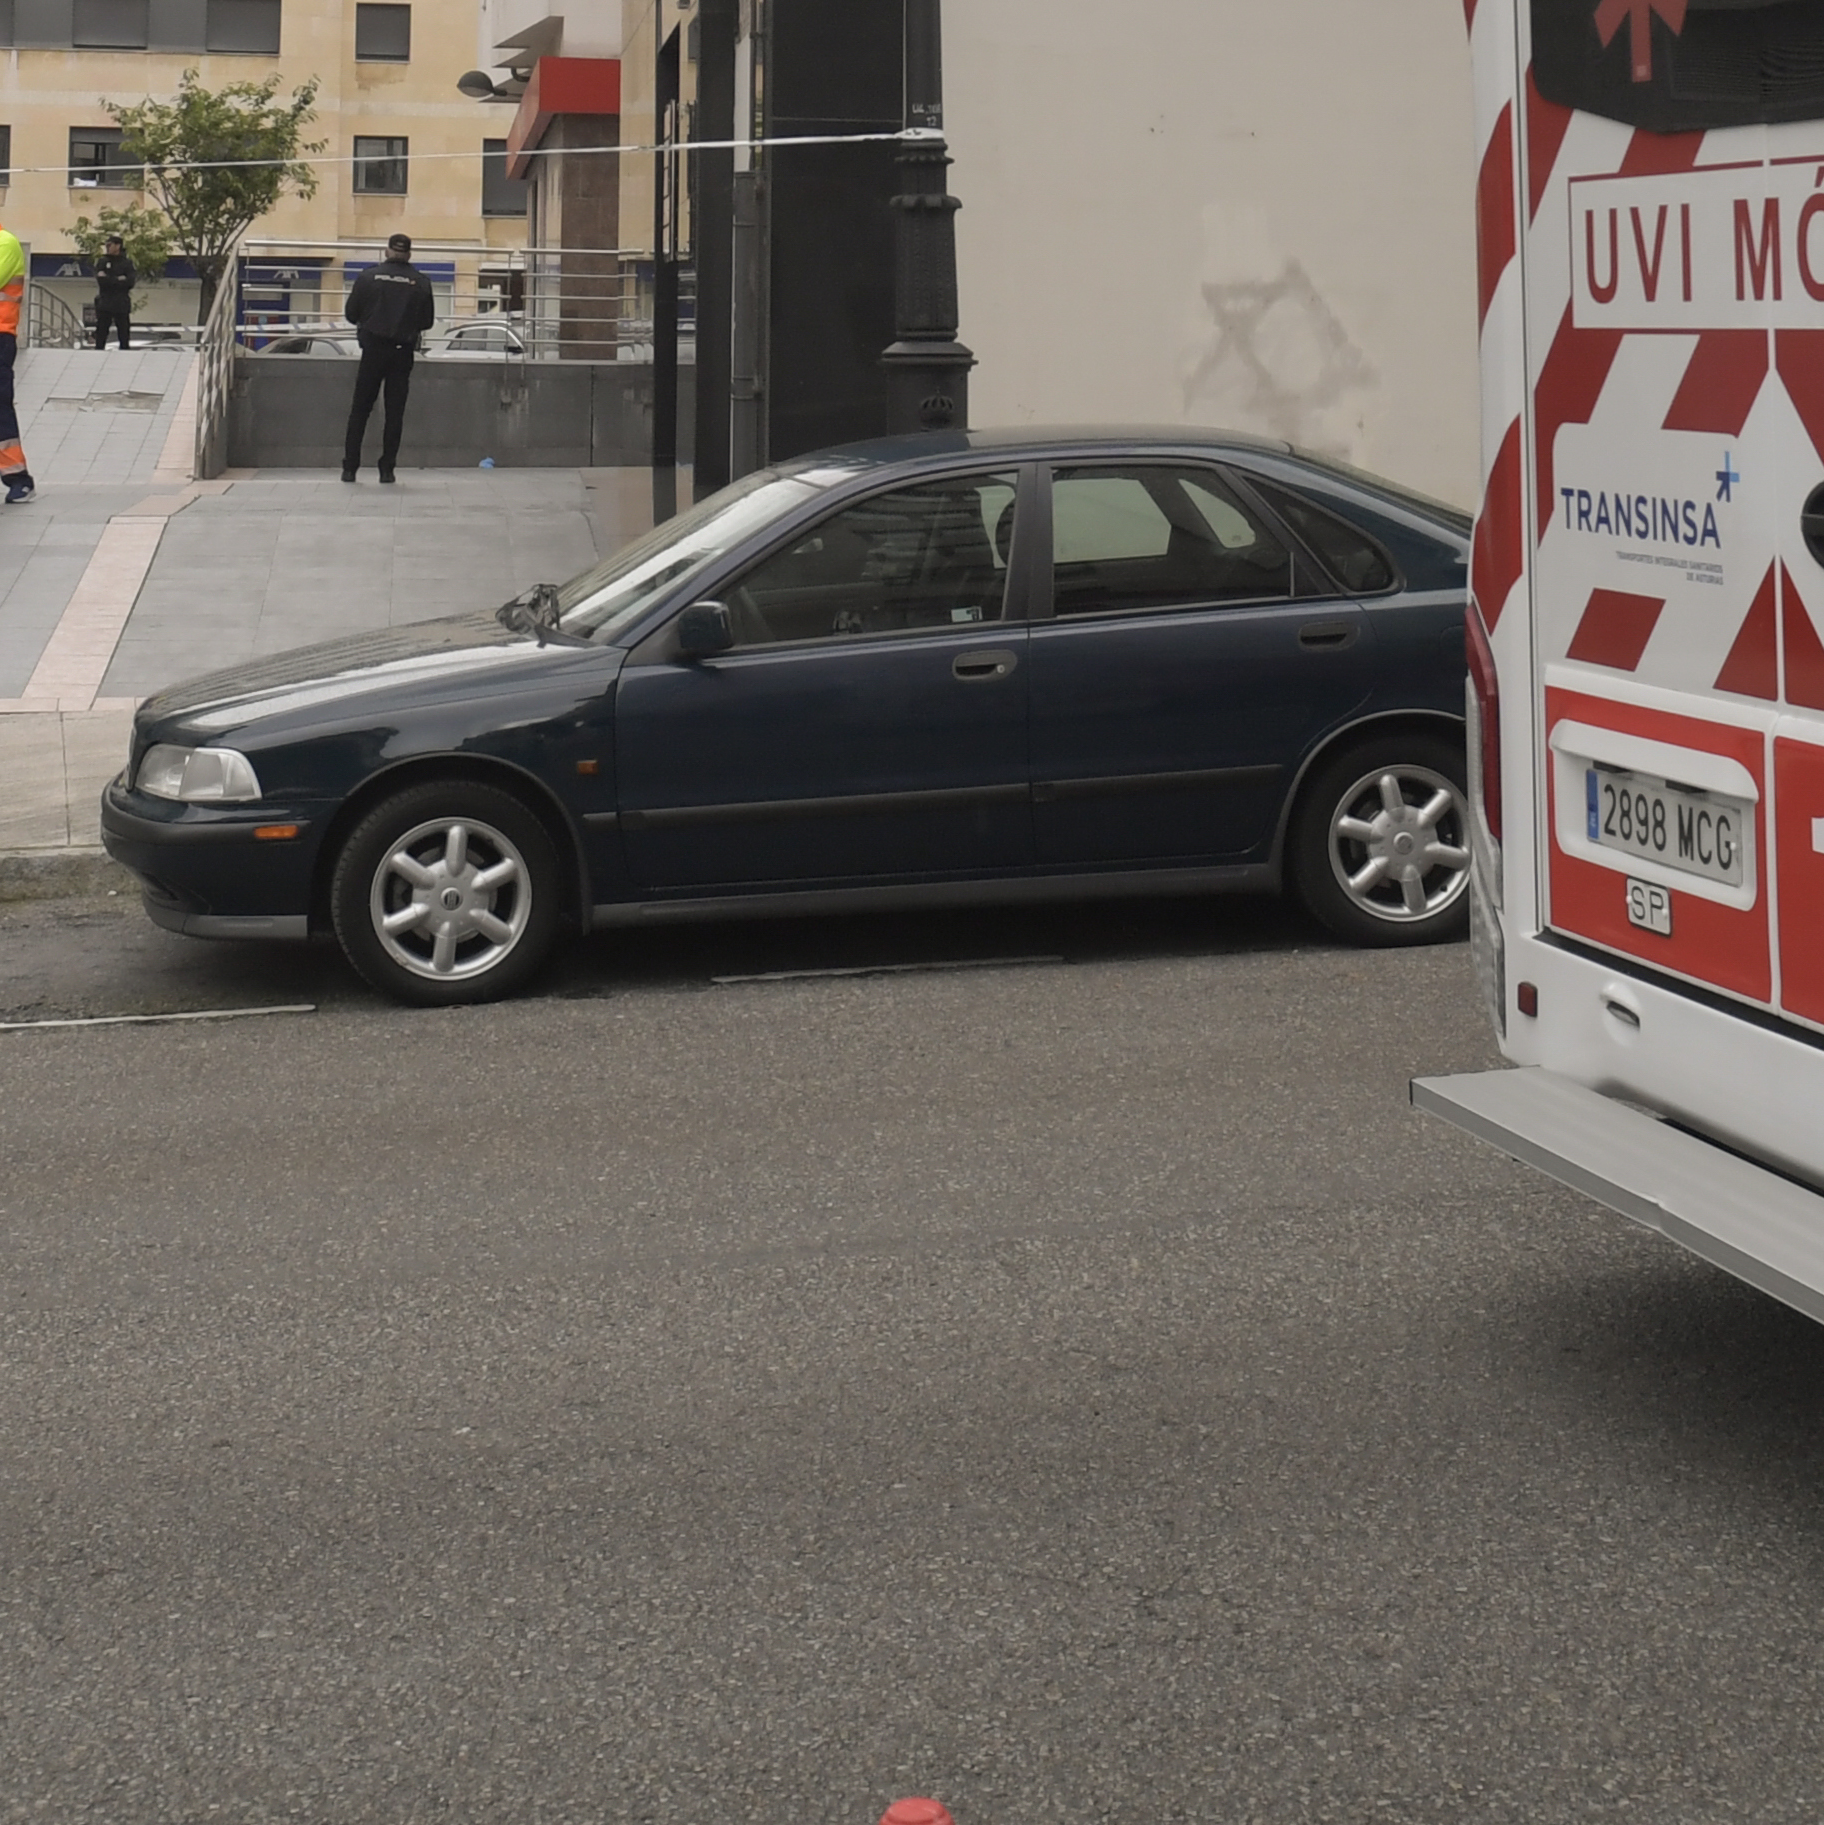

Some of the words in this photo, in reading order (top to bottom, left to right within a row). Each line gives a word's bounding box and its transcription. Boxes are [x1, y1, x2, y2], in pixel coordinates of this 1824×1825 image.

[1584, 202, 1693, 304] UVI
[1560, 487, 1722, 549] TRANSINSA
[1603, 783, 1667, 852] 2898
[1677, 803, 1733, 871] MCG
[1631, 886, 1665, 925] SP
